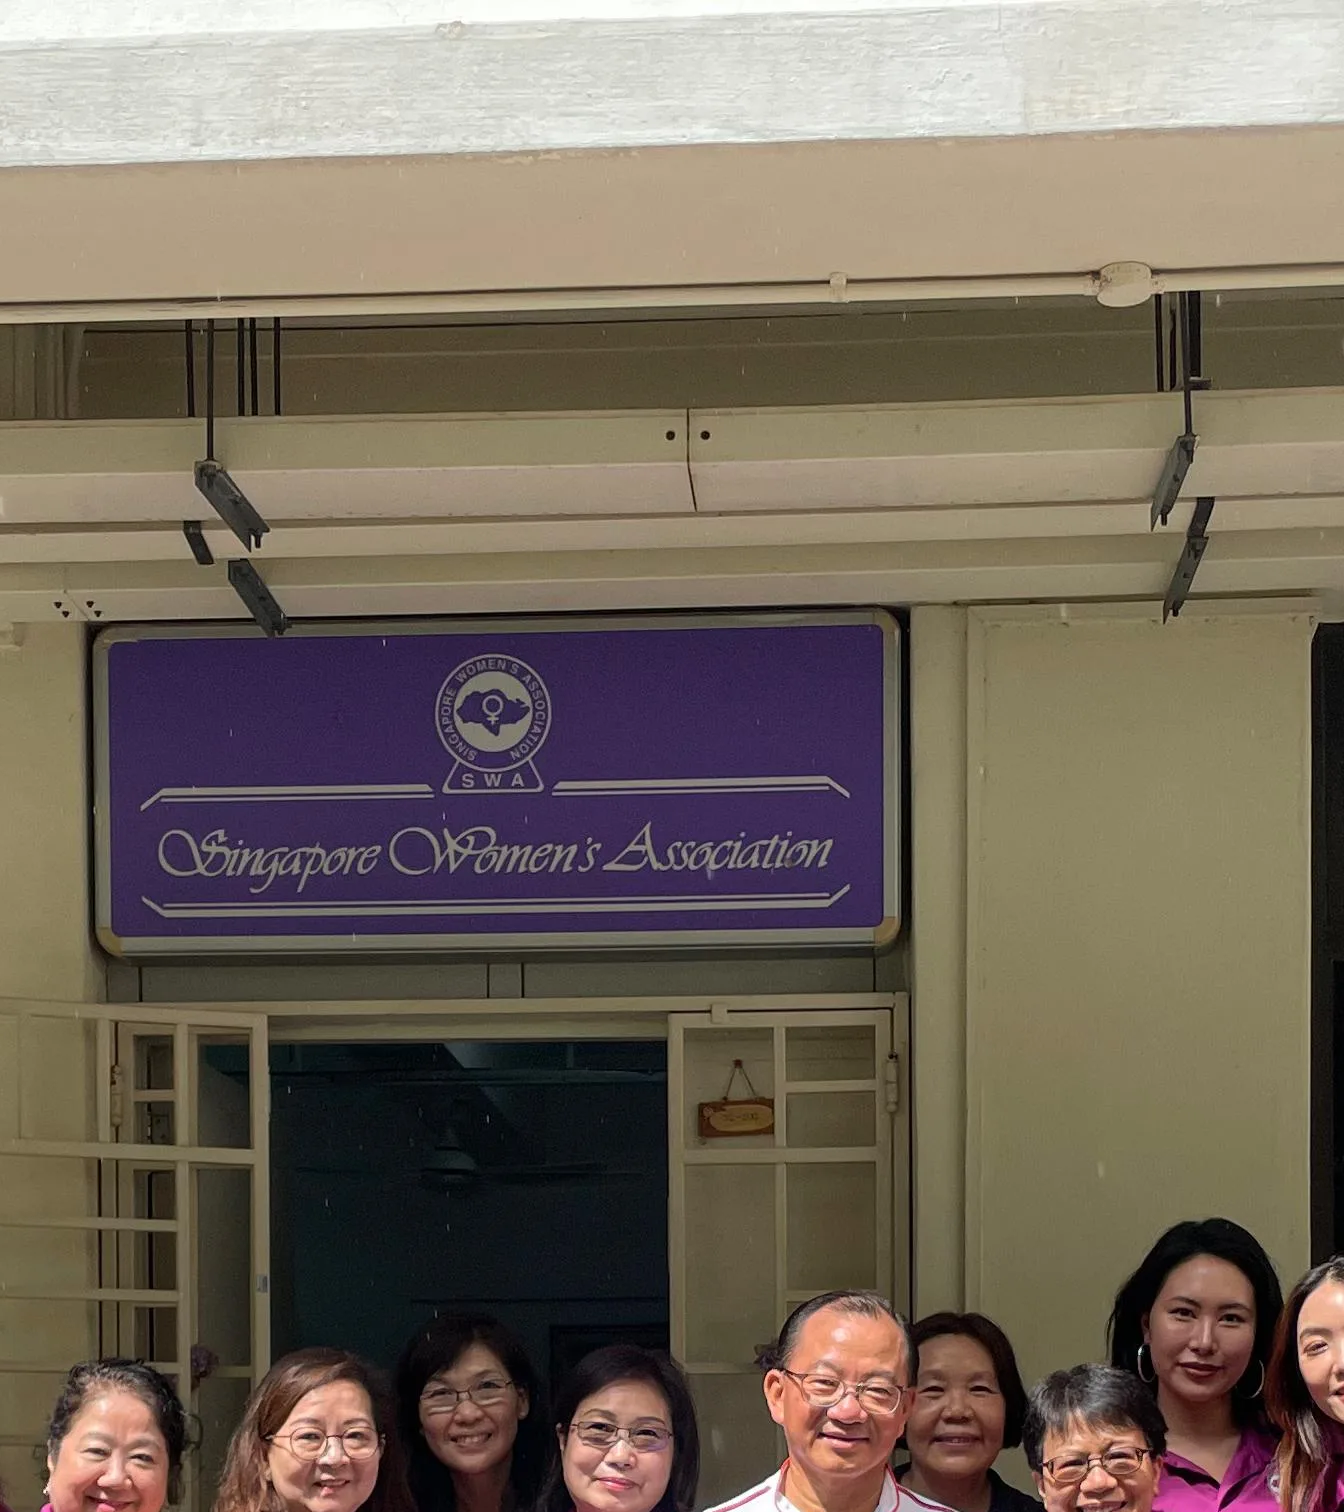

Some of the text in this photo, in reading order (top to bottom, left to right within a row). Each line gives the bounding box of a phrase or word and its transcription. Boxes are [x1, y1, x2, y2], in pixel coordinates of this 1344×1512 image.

[440, 659, 547, 761] SINGAPORE WOMEN'S ASSOCIATION
[461, 772, 525, 788] SWA
[158, 820, 834, 893] Singapore Women's Association
